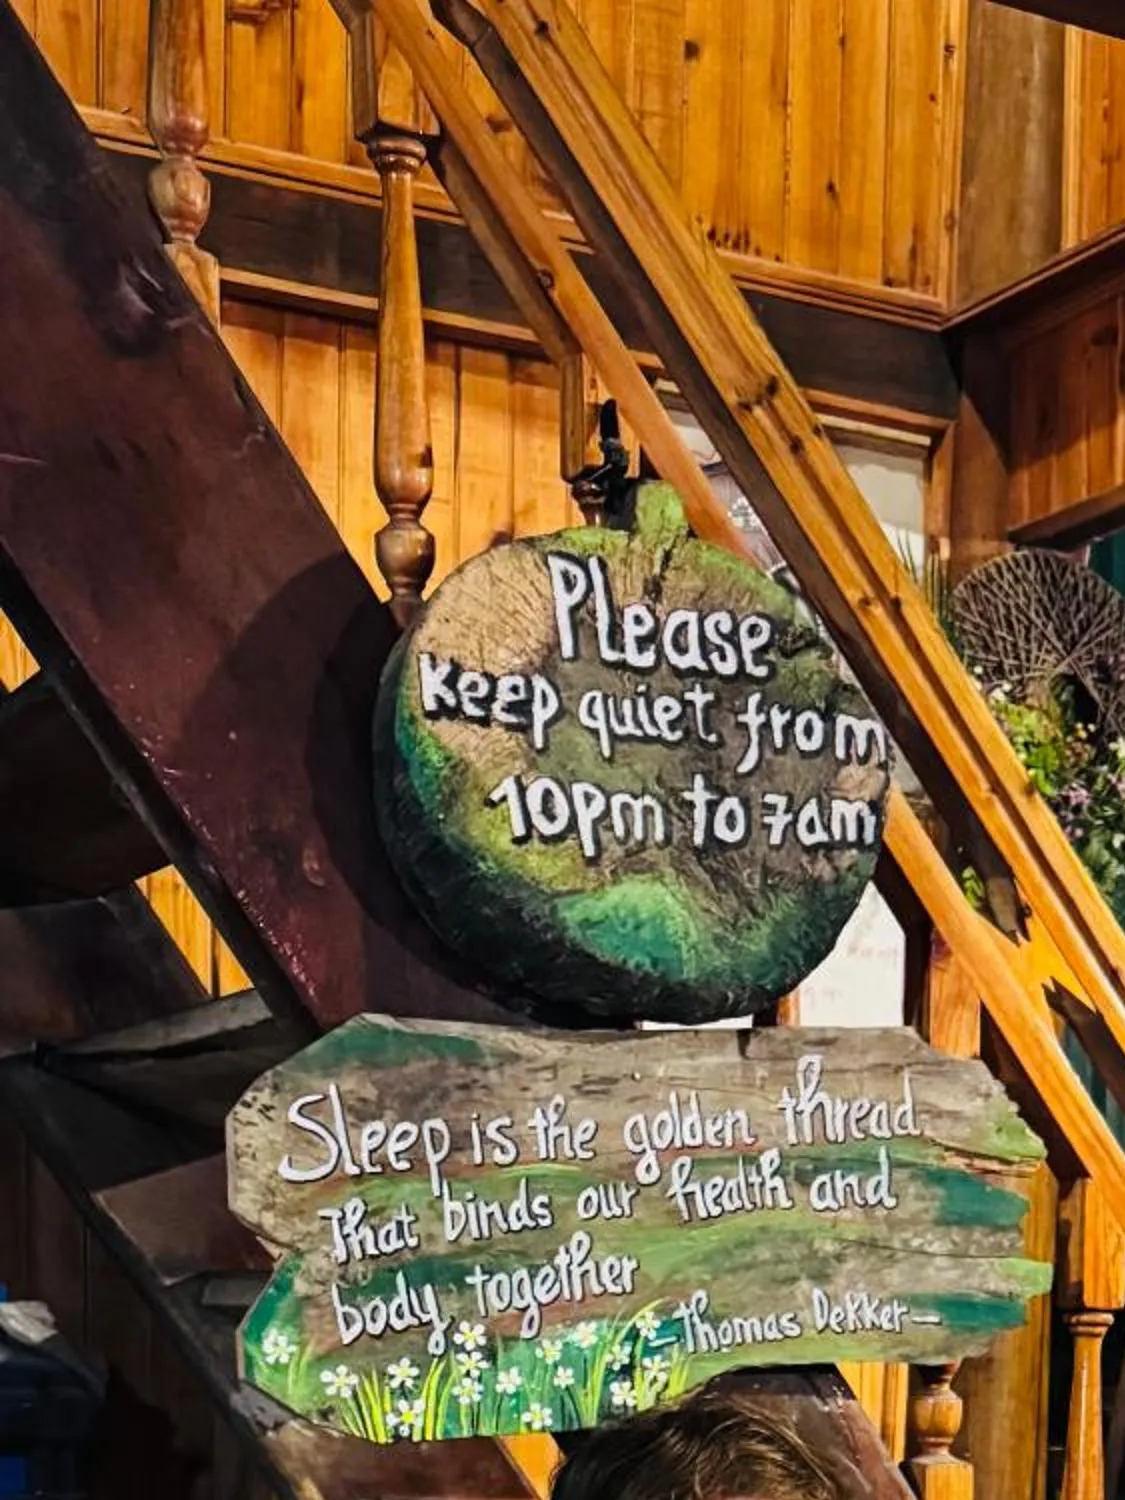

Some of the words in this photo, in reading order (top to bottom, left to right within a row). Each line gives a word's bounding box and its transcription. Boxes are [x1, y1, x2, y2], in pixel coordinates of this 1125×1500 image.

[547, 554, 772, 678] Please
[577, 682, 719, 760] quiet
[735, 692, 887, 773] from
[489, 775, 665, 858] 10pm
[684, 774, 747, 847] to
[762, 794, 877, 846] 7am
[278, 1083, 450, 1197] Sleep
[471, 1113, 518, 1166] is
[529, 1094, 598, 1160] the
[623, 1090, 756, 1184] golden
[776, 1054, 923, 1145] thread
[442, 1177, 554, 1241] binds
[577, 1182, 639, 1220] our
[666, 1148, 793, 1222] health
[810, 1146, 898, 1211] and
[331, 1270, 452, 1356] body
[465, 1230, 638, 1339] together
